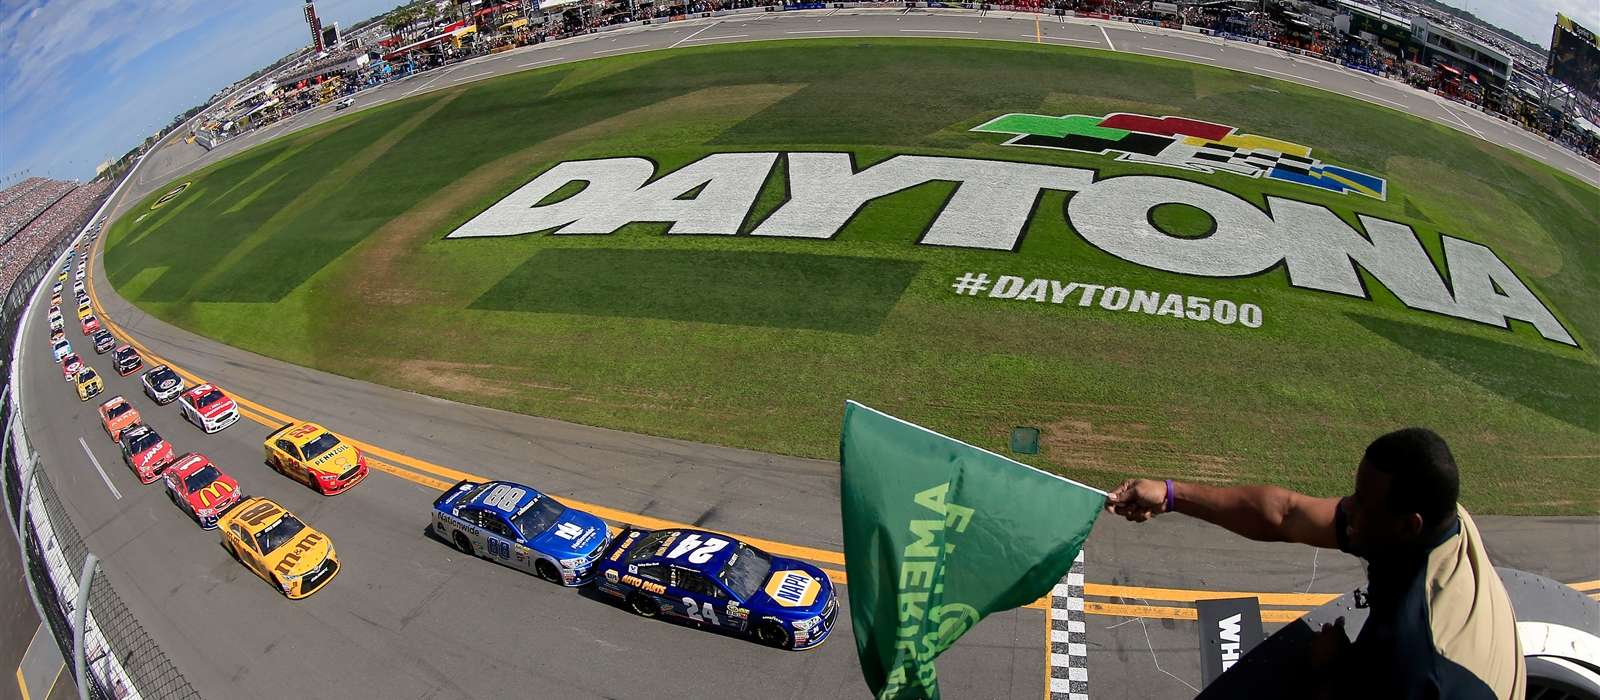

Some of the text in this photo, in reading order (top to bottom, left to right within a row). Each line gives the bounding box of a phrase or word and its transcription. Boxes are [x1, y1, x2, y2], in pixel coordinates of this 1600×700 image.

[446, 151, 1580, 348] DAYTONA
[952, 271, 1264, 329] #DAYTONA500
[141, 440, 165, 466] HAAS
[314, 444, 350, 466] PENNZOIL
[482, 484, 527, 513] 88
[239, 502, 284, 527] 18
[437, 511, 480, 538] Nationwide
[487, 536, 511, 560] 88
[666, 534, 730, 564] 24
[621, 574, 643, 588] AUTO
[641, 581, 667, 595] PARTS
[777, 573, 810, 603] NAPA
[682, 597, 721, 626] 24
